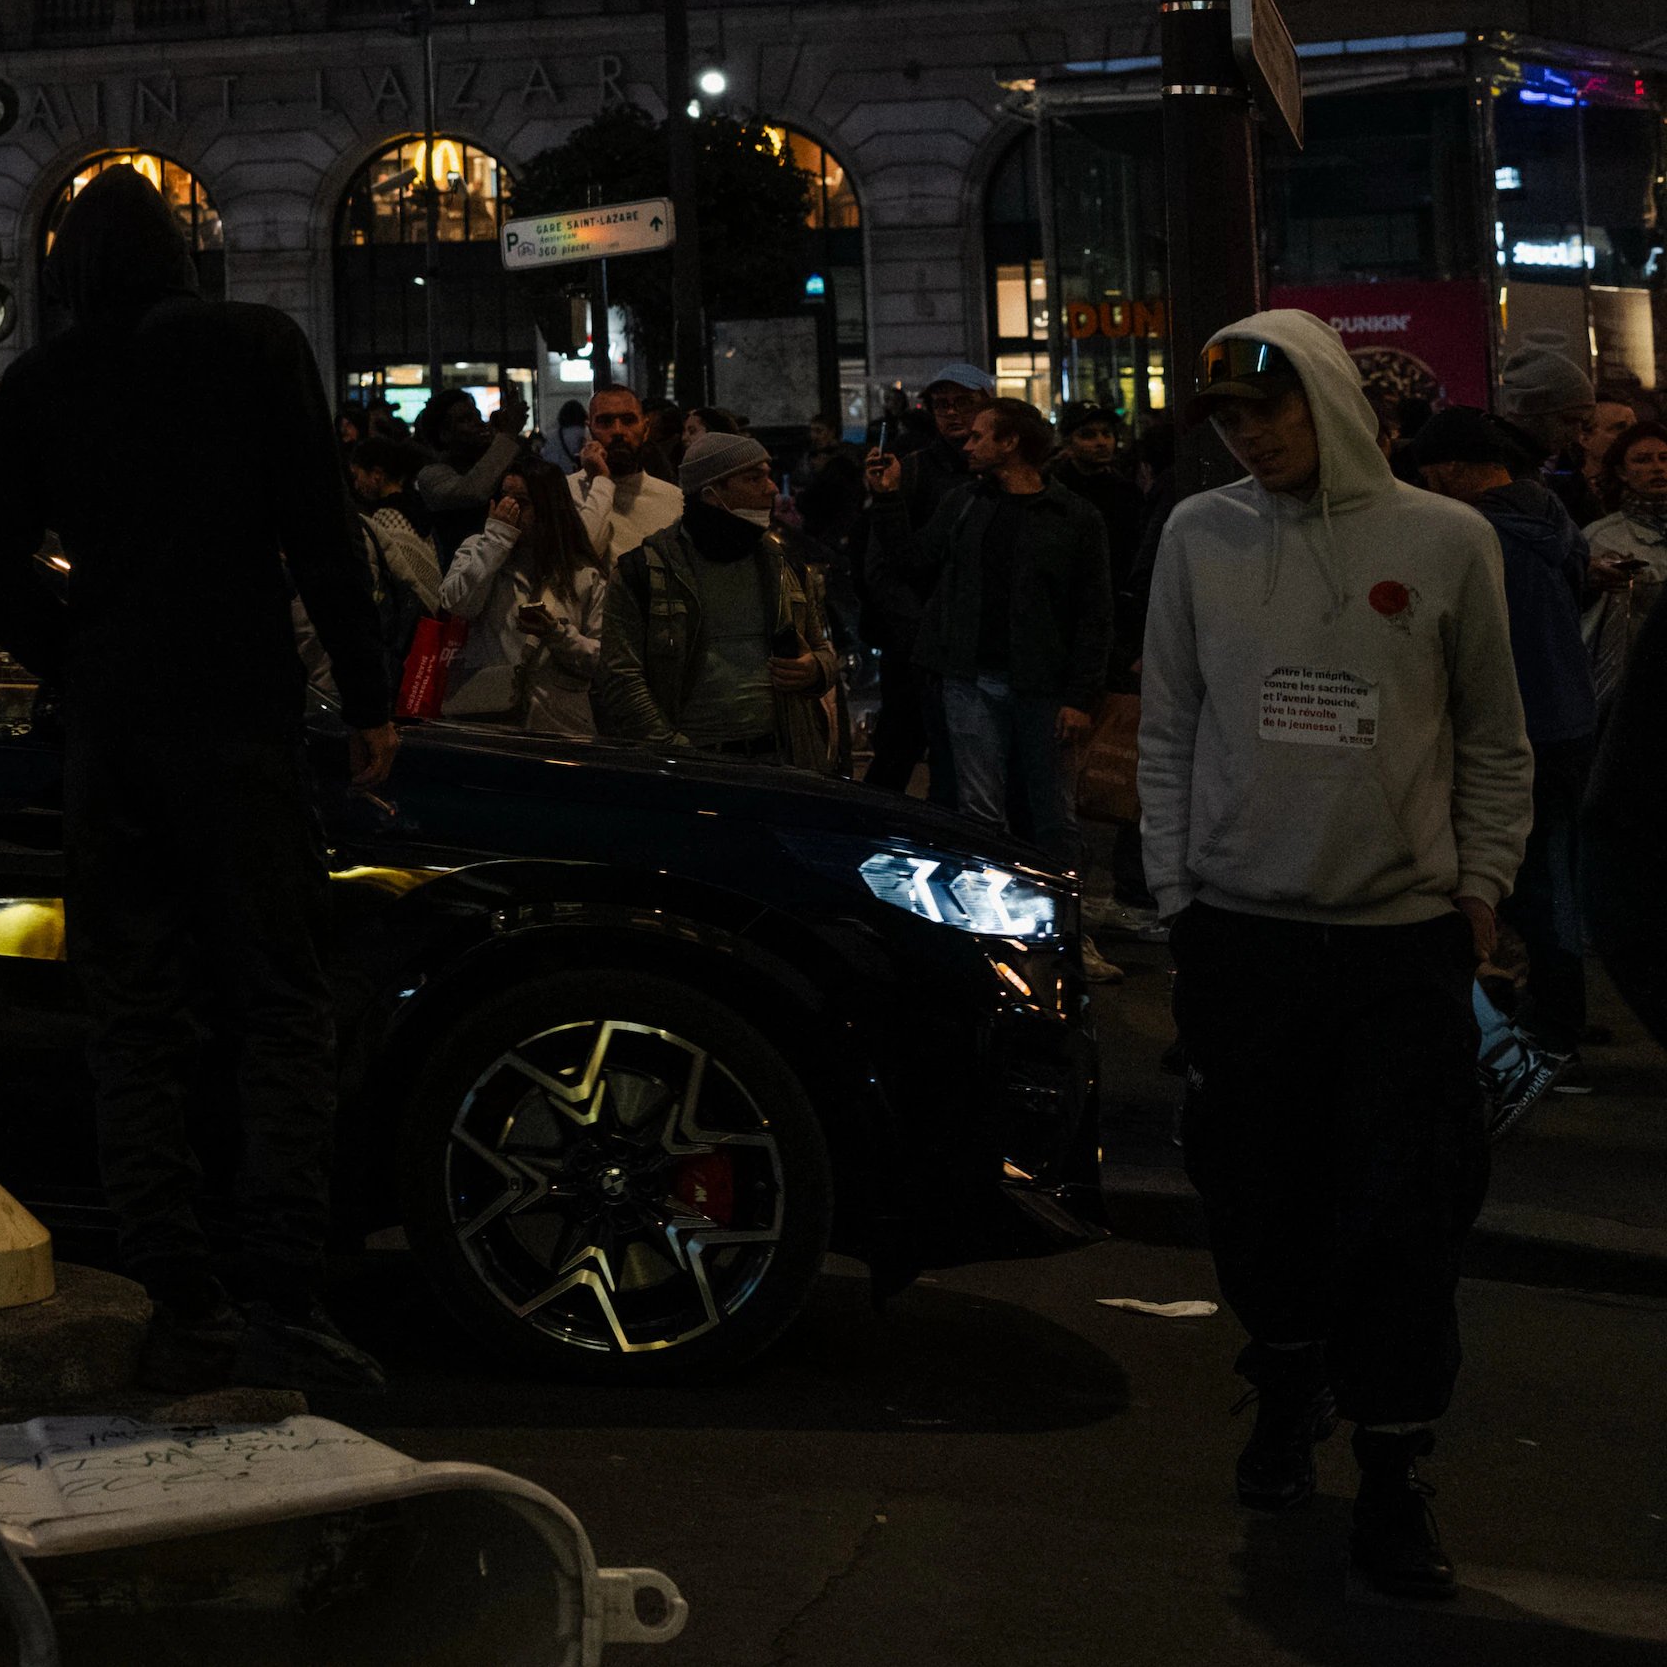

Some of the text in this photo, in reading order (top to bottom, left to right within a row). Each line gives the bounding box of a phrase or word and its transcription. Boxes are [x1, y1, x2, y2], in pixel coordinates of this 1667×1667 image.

[313, 52, 629, 112] LAZAR
[536, 211, 639, 234] GARE SAINT-LAZARE
[1303, 668, 1312, 678] le
[1264, 680, 1369, 696] contre les sacrifices
[1263, 692, 1360, 709] et l'avenir bouché,
[1262, 705, 1337, 719] vive la révolte
[1263, 717, 1275, 727] de
[1277, 718, 1286, 727] la
[1289, 719, 1336, 732] jeunesse
